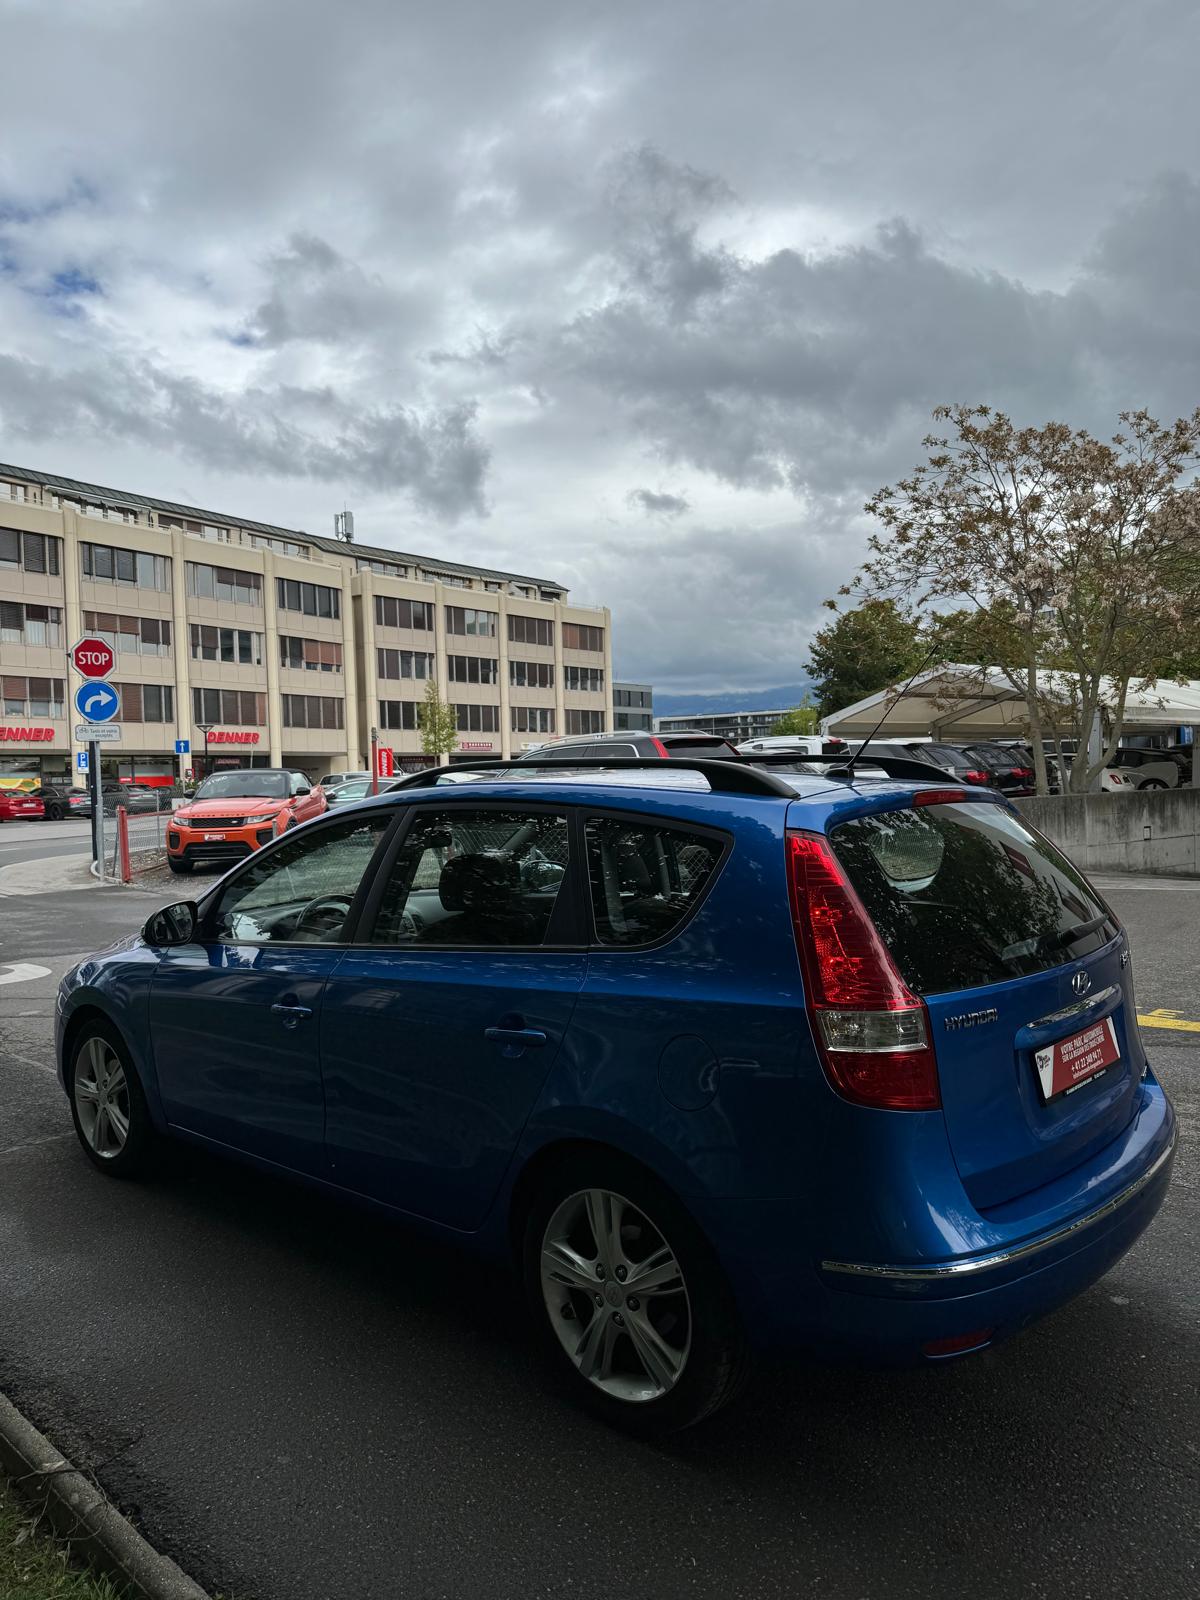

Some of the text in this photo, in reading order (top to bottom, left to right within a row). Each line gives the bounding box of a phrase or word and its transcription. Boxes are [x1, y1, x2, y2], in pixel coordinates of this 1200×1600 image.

[78, 651, 110, 665] STOP
[207, 731, 260, 744] DENNER
[80, 753, 86, 761] P
[944, 1008, 999, 1031] HYUNDAI
[1075, 1060, 1080, 1071] 41
[1080, 1057, 1086, 1068] 22
